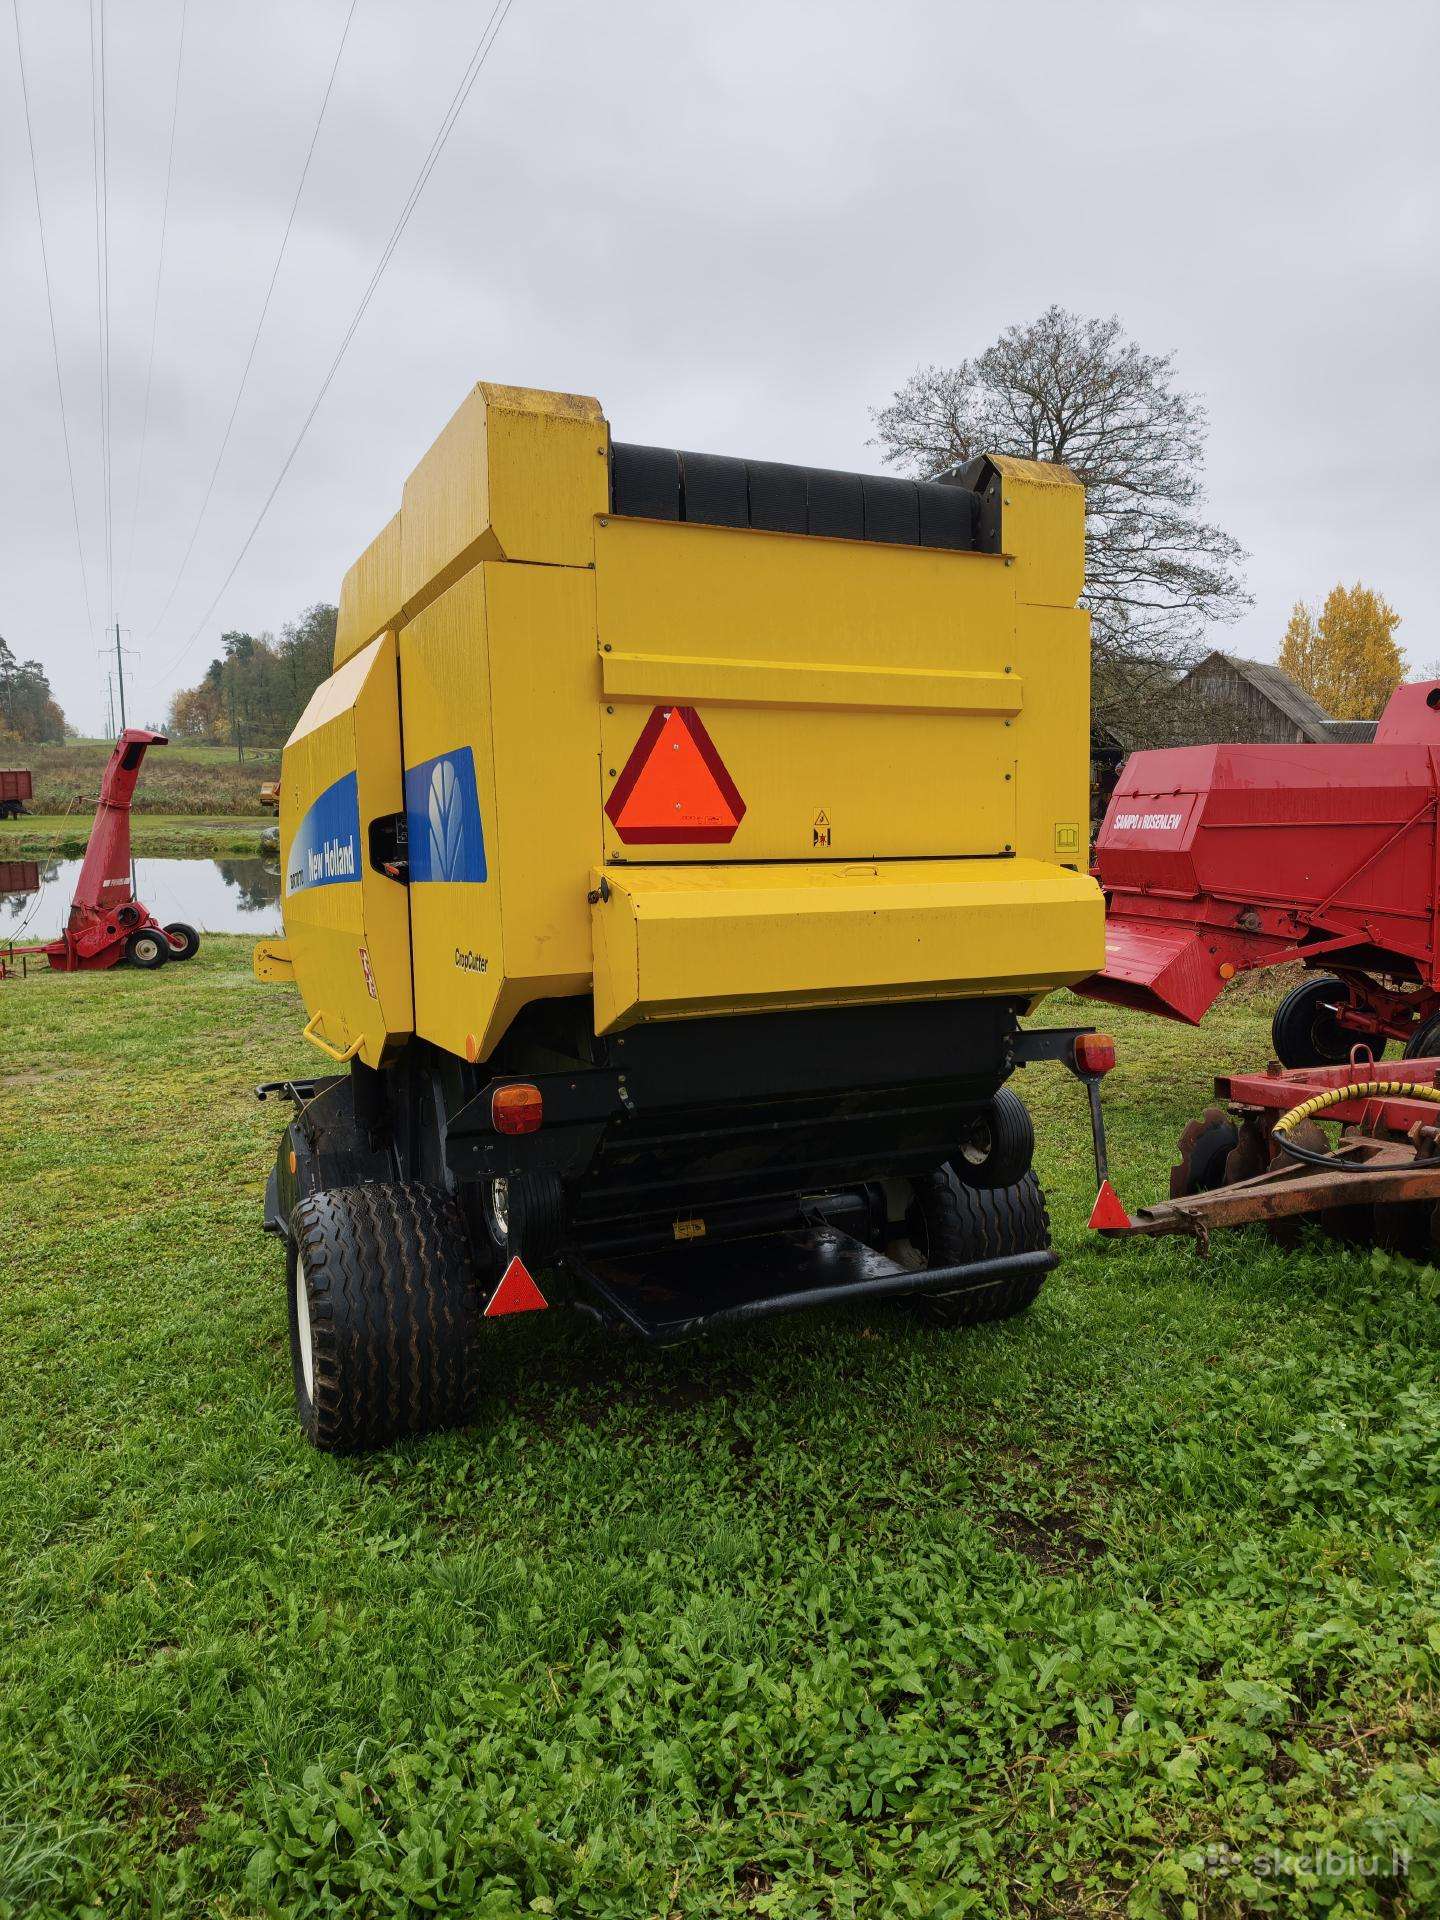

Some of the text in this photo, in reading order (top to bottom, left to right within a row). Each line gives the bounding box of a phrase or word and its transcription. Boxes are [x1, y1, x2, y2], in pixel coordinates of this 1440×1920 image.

[1114, 814, 1182, 830] SAMPO ROSENLEW
[308, 834, 355, 881] New Holland
[454, 947, 488, 973] CropCutter
